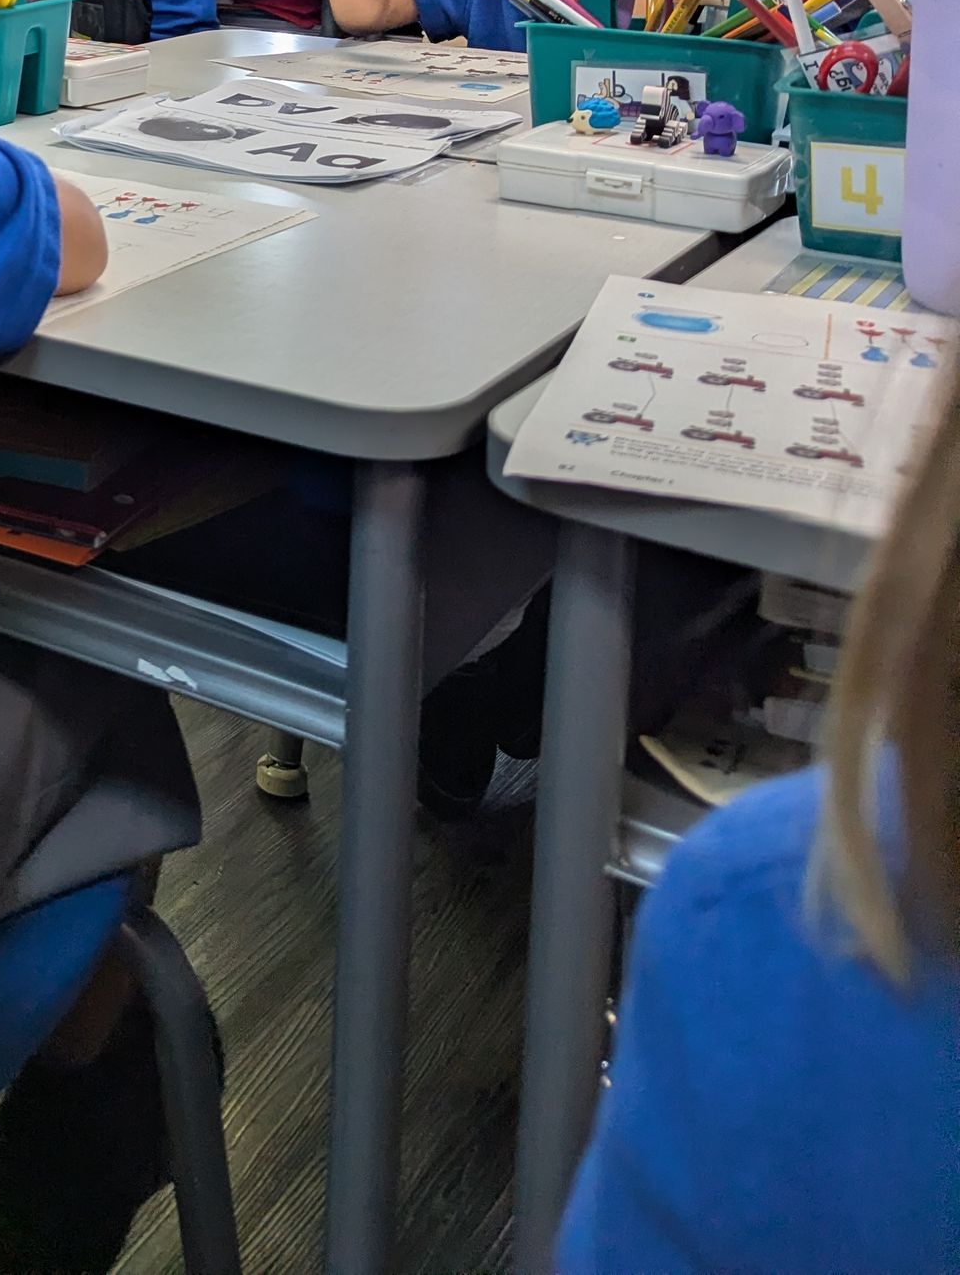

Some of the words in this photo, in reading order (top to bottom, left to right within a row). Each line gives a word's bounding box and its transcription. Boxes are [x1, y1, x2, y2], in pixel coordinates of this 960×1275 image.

[612, 70, 626, 98] b
[247, 142, 387, 170] Aa
[840, 163, 884, 215] 4
